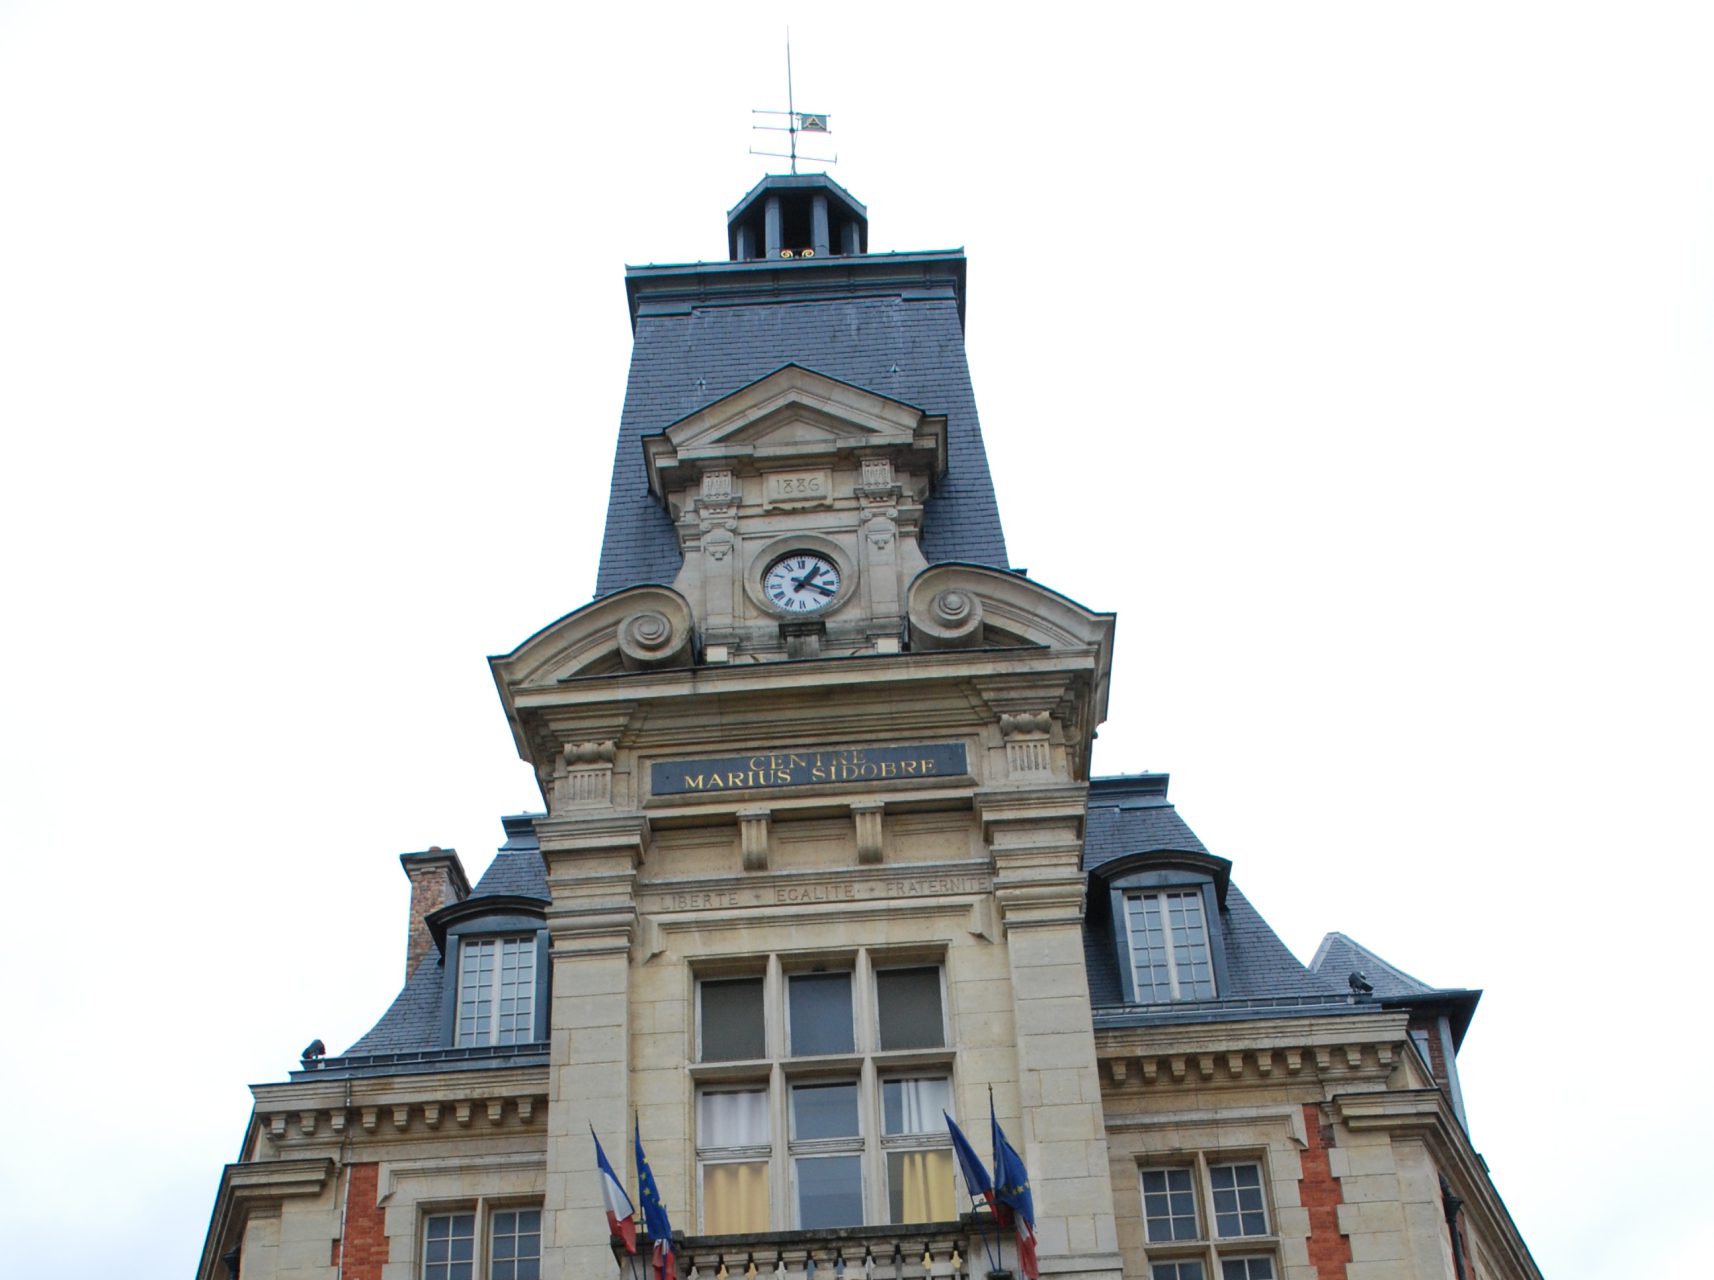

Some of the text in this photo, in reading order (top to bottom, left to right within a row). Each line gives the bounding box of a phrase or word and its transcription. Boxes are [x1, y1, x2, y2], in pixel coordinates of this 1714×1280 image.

[776, 477, 820, 495] 1886
[750, 749, 866, 772] CENTRE
[684, 759, 936, 789] MARIUS SIDOBRE
[660, 877, 987, 910] LIBERTE EGALITE FRATERNITE
